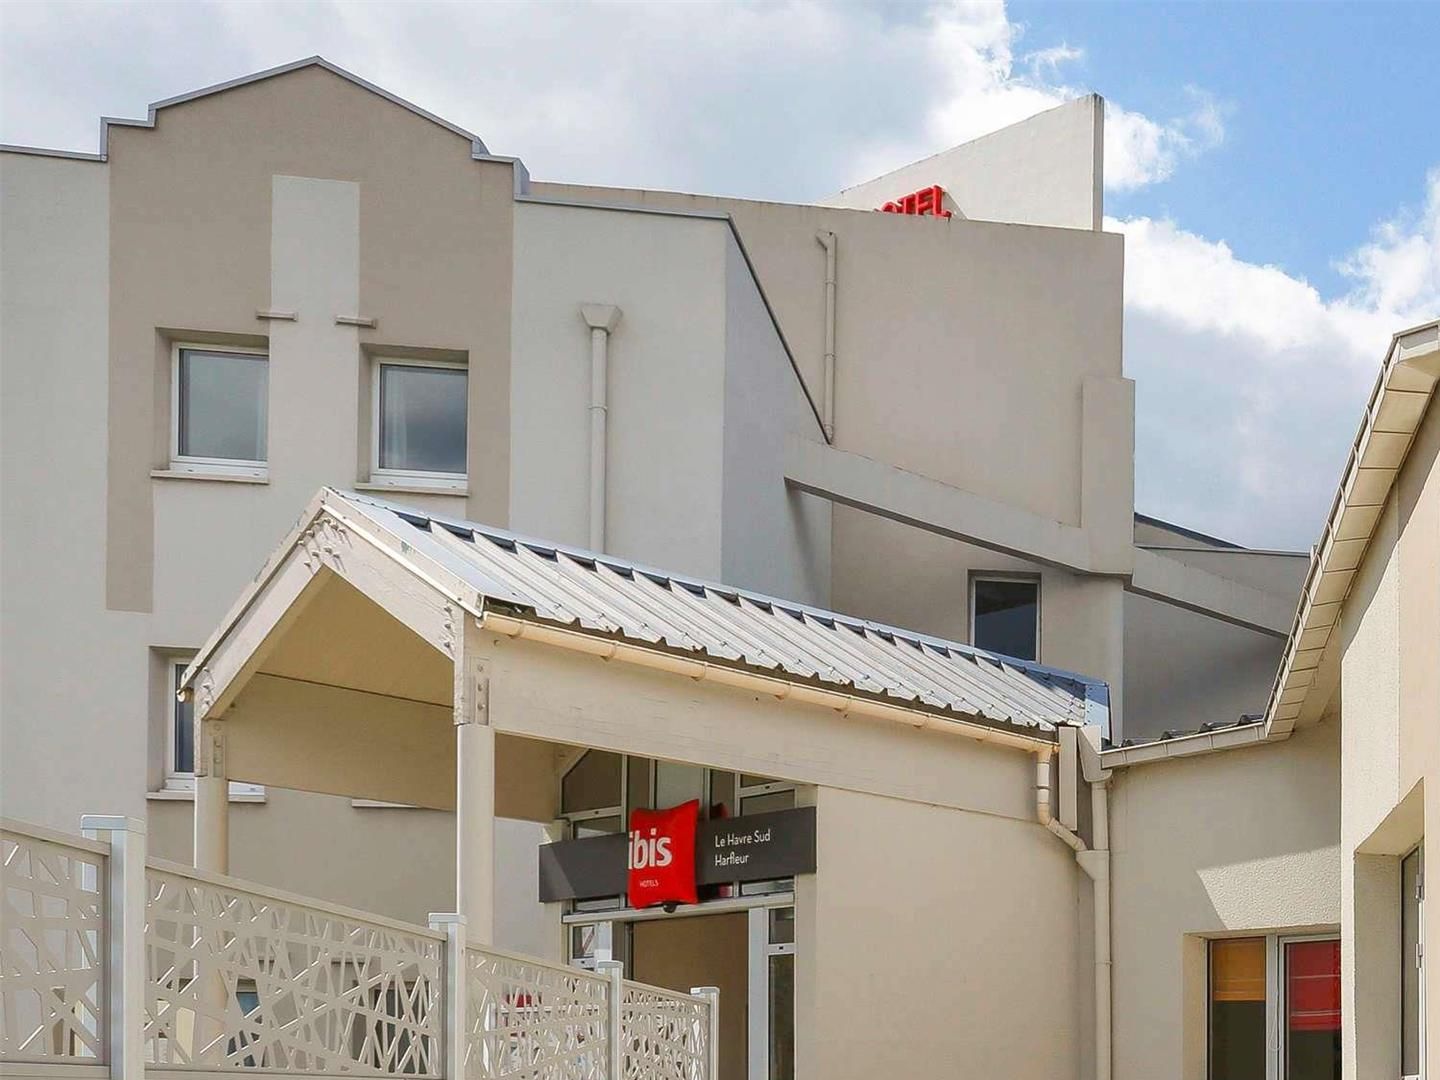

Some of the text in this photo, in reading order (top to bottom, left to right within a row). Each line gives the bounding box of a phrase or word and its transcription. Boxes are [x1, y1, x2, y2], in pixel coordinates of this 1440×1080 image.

[715, 827, 771, 848] Le Havre Sud
[628, 828, 673, 870] ibis
[714, 852, 749, 867] Harfleur
[639, 878, 659, 888] HOTELS
